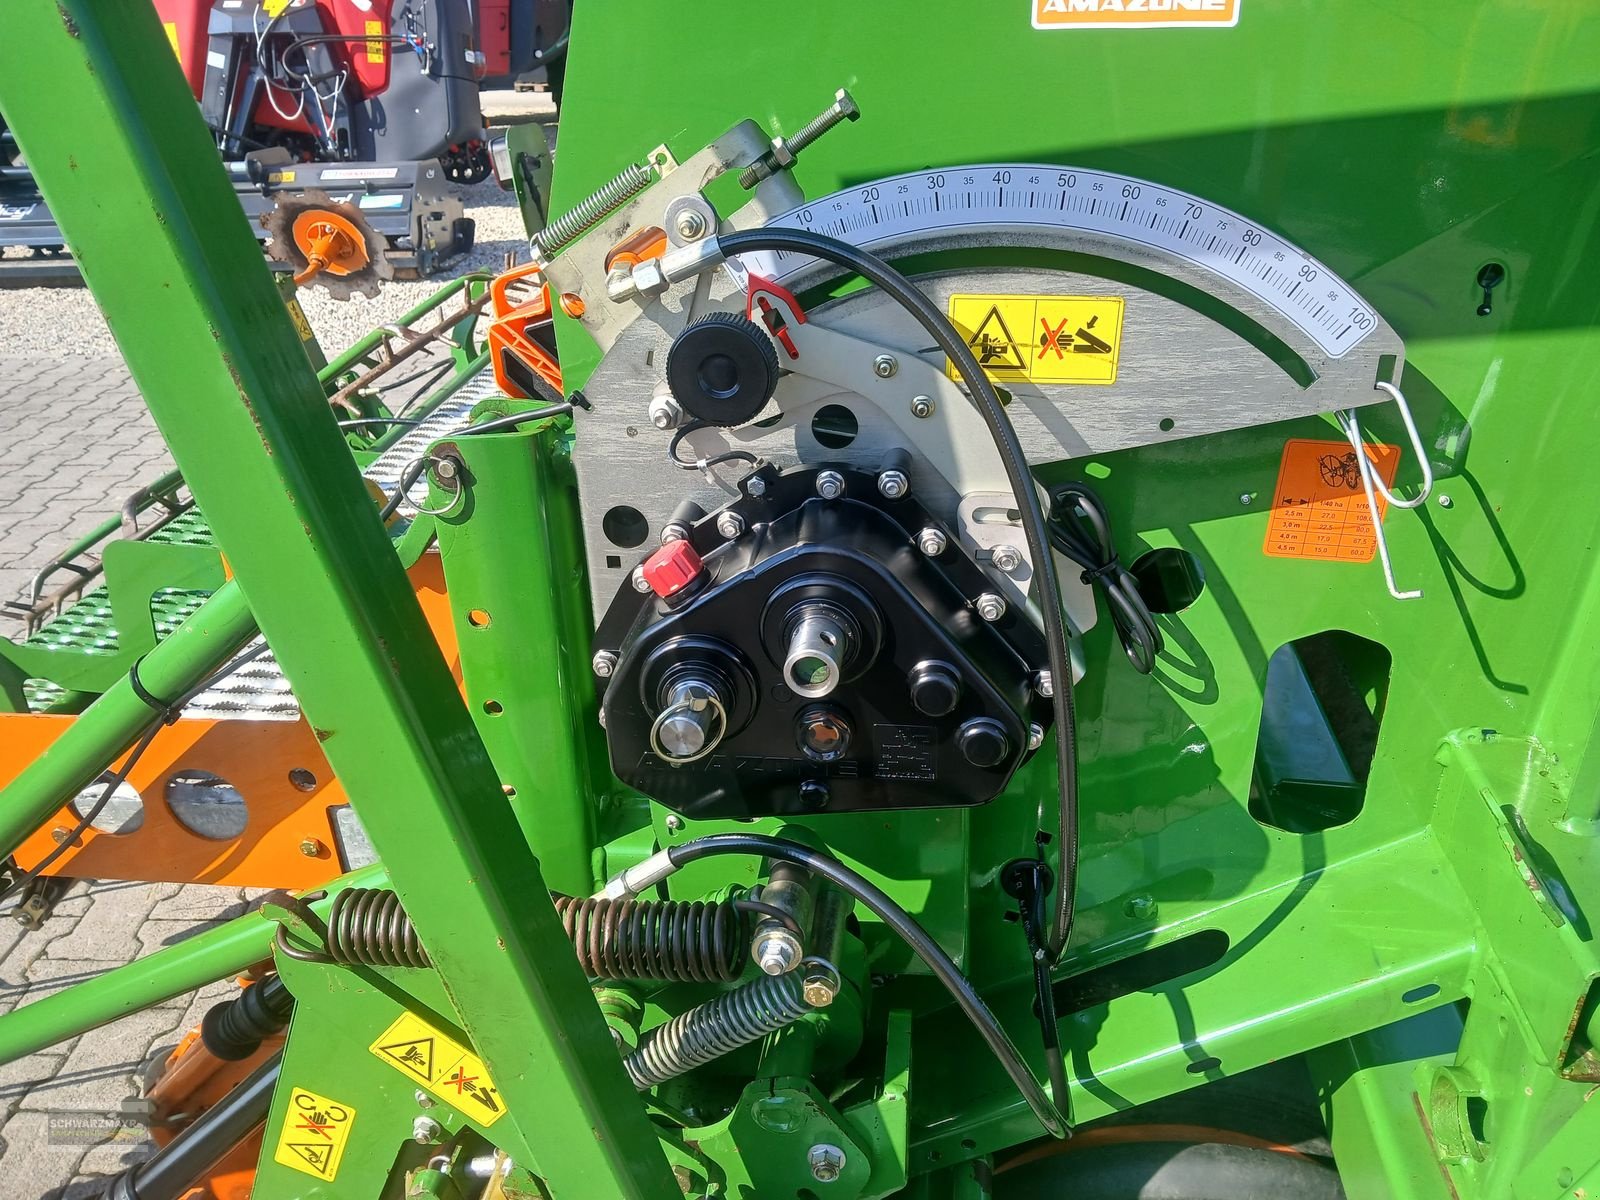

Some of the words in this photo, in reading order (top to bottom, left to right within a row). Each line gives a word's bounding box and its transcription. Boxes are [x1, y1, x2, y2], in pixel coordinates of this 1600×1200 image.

[795, 209, 814, 226] 10
[831, 202, 843, 212] 15
[861, 187, 880, 203] 20
[897, 185, 908, 194] 25
[927, 174, 945, 190] 30
[963, 176, 974, 185] 35
[992, 170, 1011, 185] 40
[1028, 176, 1040, 185] 45
[1057, 173, 1076, 188] 50
[1092, 183, 1104, 192] 55
[1121, 185, 1141, 200] 60
[1155, 197, 1168, 208] 65
[1183, 202, 1203, 220] 70
[1216, 219, 1228, 231] 75
[1241, 229, 1262, 247] 80
[1274, 251, 1286, 262] 85
[1297, 264, 1318, 283] 90
[1327, 291, 1339, 302] 95
[1348, 306, 1372, 331] 100
